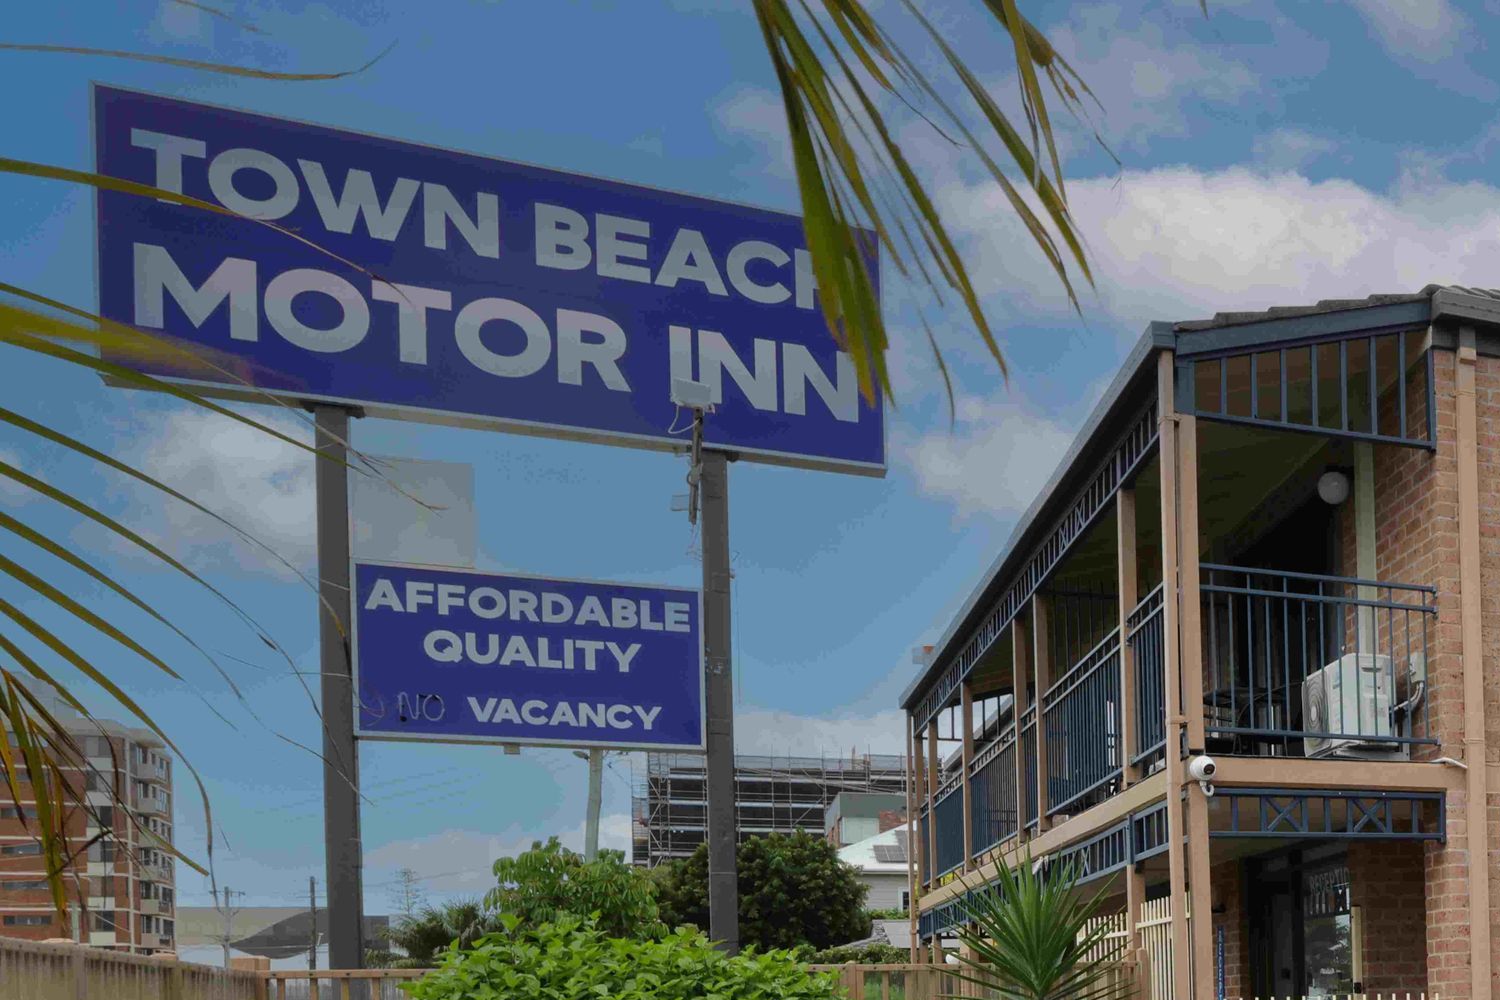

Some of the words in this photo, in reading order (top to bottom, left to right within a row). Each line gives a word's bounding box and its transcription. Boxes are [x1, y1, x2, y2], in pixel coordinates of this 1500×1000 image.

[130, 127, 500, 260] TOWN
[133, 242, 632, 393] MOTOR
[668, 325, 859, 423] INN
[364, 578, 691, 633] AFFORDABLE
[423, 629, 642, 673] QUALITY
[397, 691, 446, 721] NO
[466, 696, 662, 730] VACANCY
